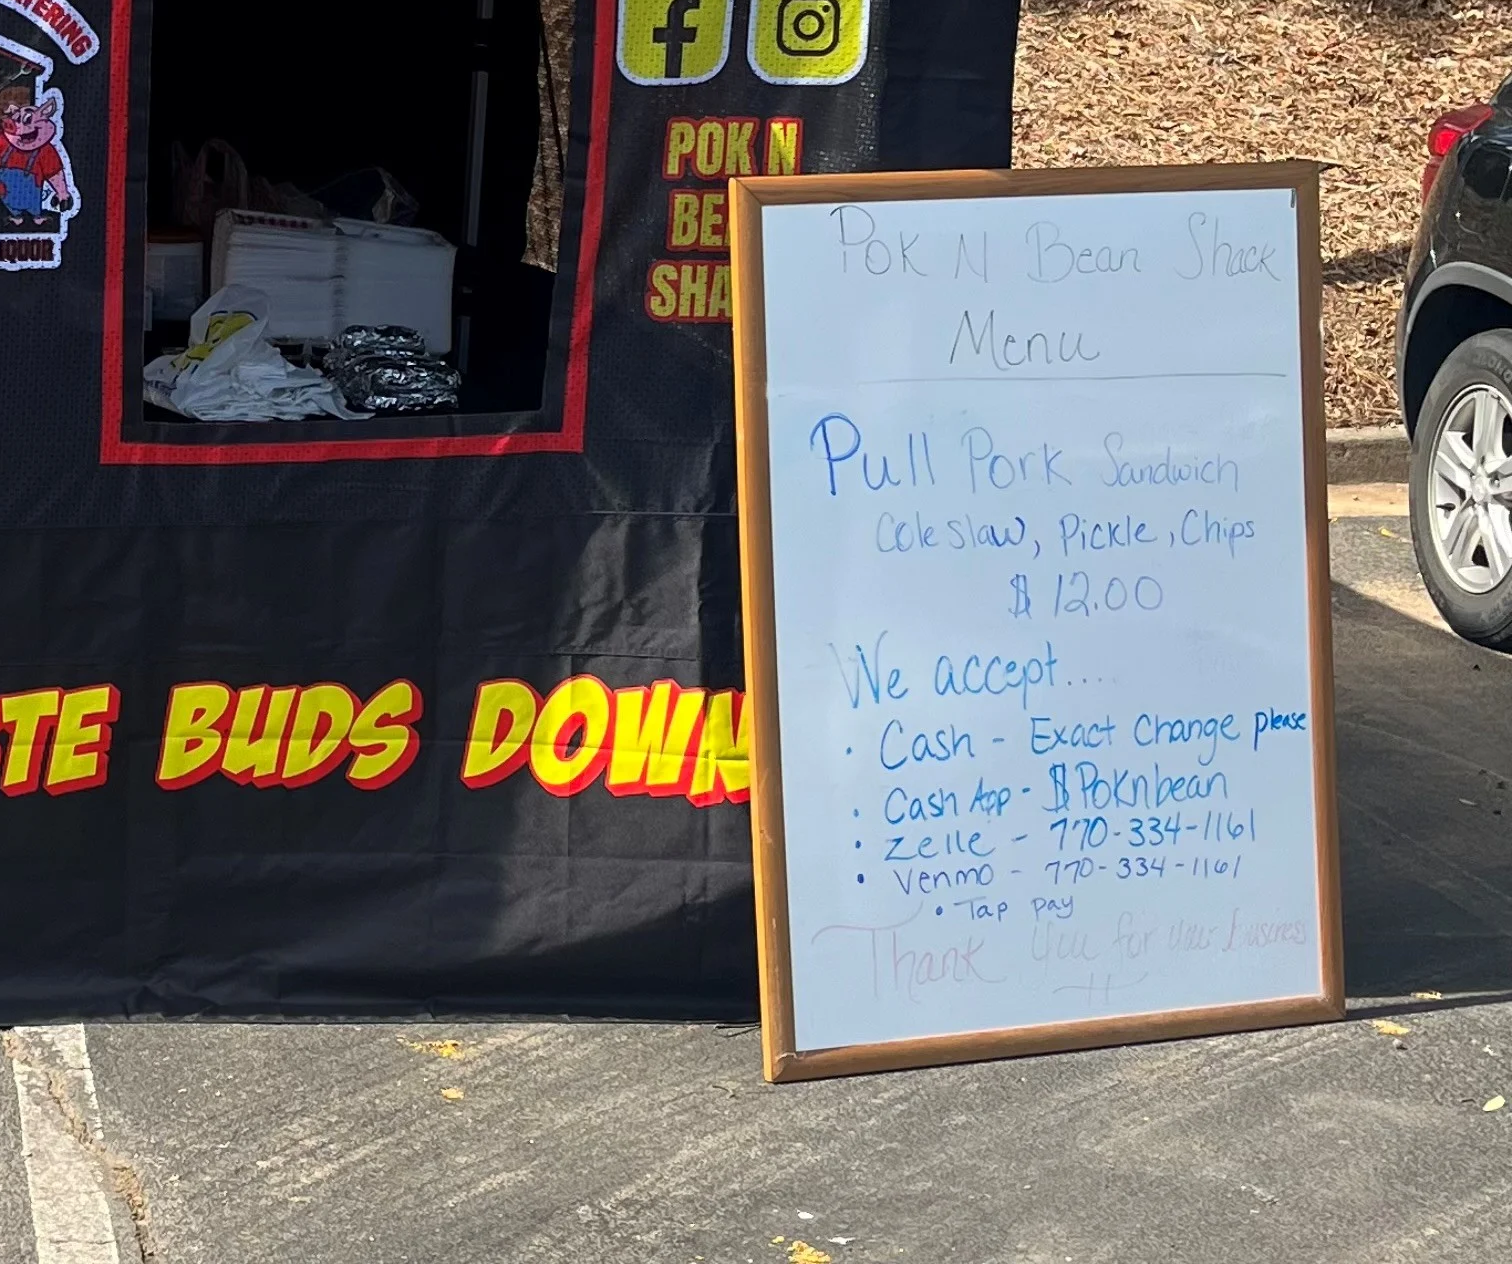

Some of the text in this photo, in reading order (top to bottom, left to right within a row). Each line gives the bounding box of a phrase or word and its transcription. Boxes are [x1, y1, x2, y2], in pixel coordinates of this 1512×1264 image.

[665, 120, 801, 177] POK N
[670, 192, 731, 247] BE
[954, 230, 988, 283] N
[1024, 221, 1142, 282] Bean
[1172, 211, 1281, 281] Shack
[648, 263, 734, 318] SHA
[949, 309, 1101, 371] Menu
[810, 412, 1239, 496] Pull Pork Sandwich
[828, 630, 909, 709] We
[156, 678, 424, 791] BUDS
[461, 673, 751, 806] DOWN
[880, 718, 976, 770] Cash
[1030, 714, 1117, 755] Exact
[1133, 713, 1242, 767] Change
[1253, 707, 1307, 752] please
[884, 786, 959, 825] Cash
[968, 776, 1012, 817] App
[1049, 807, 1256, 852] 770-334-1161
[892, 862, 995, 896] Venmo
[1044, 854, 1242, 886] 770-334-1161
[952, 894, 1009, 923] Tap
[811, 900, 1007, 1004] Thank
